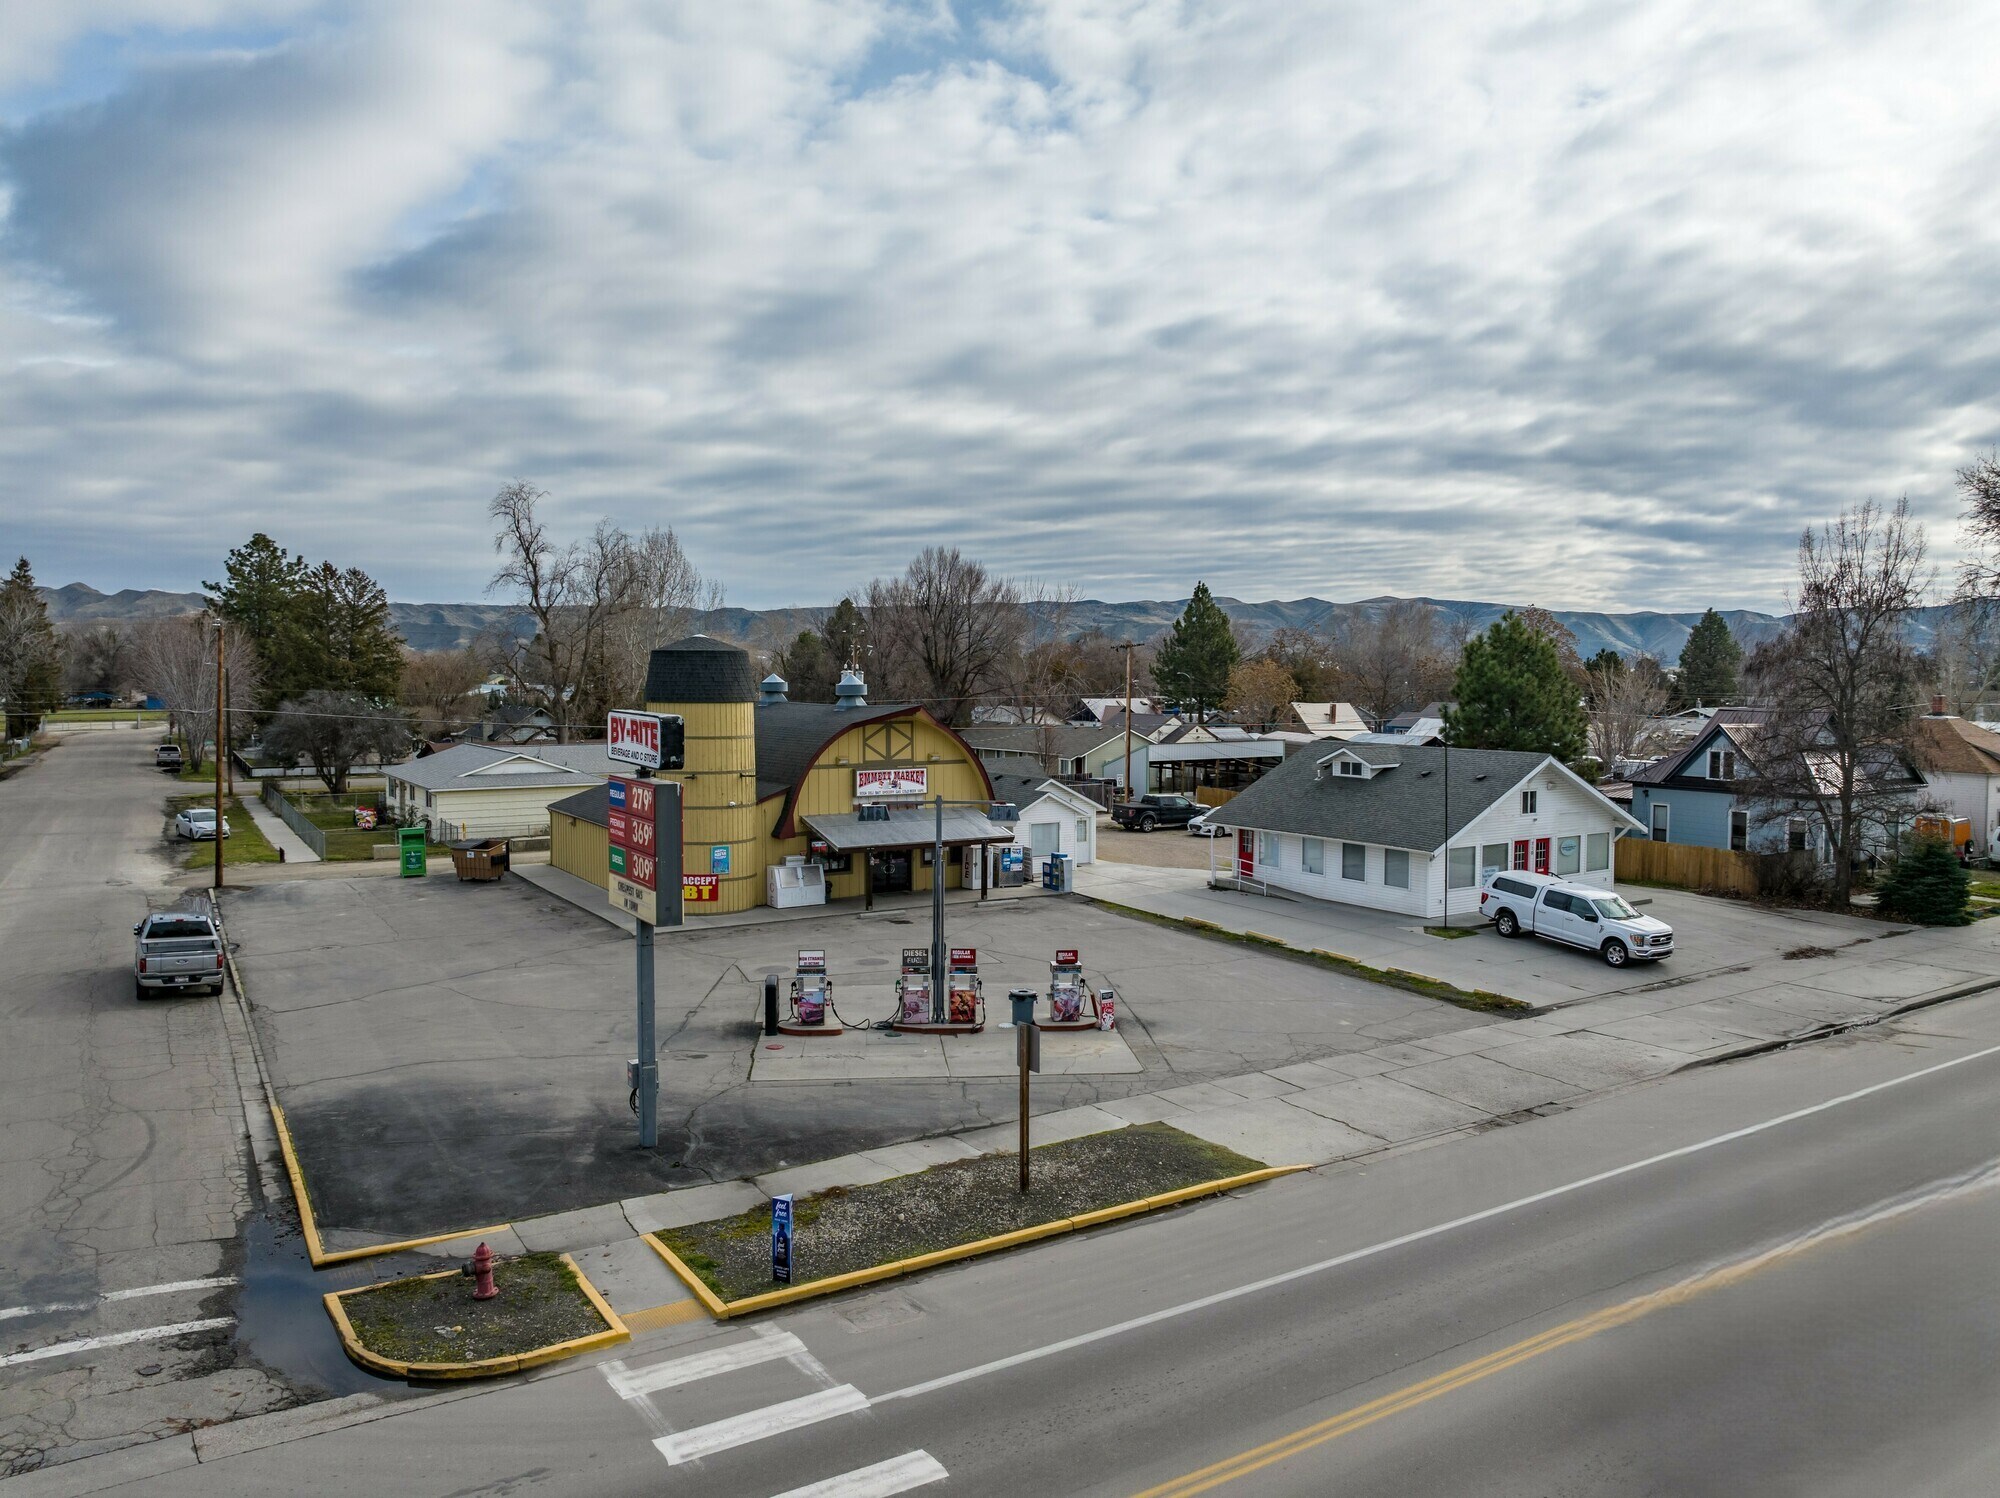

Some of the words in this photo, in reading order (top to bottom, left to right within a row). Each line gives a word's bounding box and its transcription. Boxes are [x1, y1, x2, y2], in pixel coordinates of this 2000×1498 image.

[610, 716, 658, 753] BY-RITE
[611, 746, 630, 758] BEVERAGE
[631, 751, 639, 760] AND
[644, 753, 658, 764] STORE
[859, 771, 891, 787] EMMETT
[894, 770, 924, 785] MARKET
[609, 788, 625, 799] REGULAR
[609, 817, 625, 828] PREMIUM
[612, 854, 624, 865] DIESEL
[683, 877, 717, 885] ACCEPT
[684, 886, 712, 899] BT
